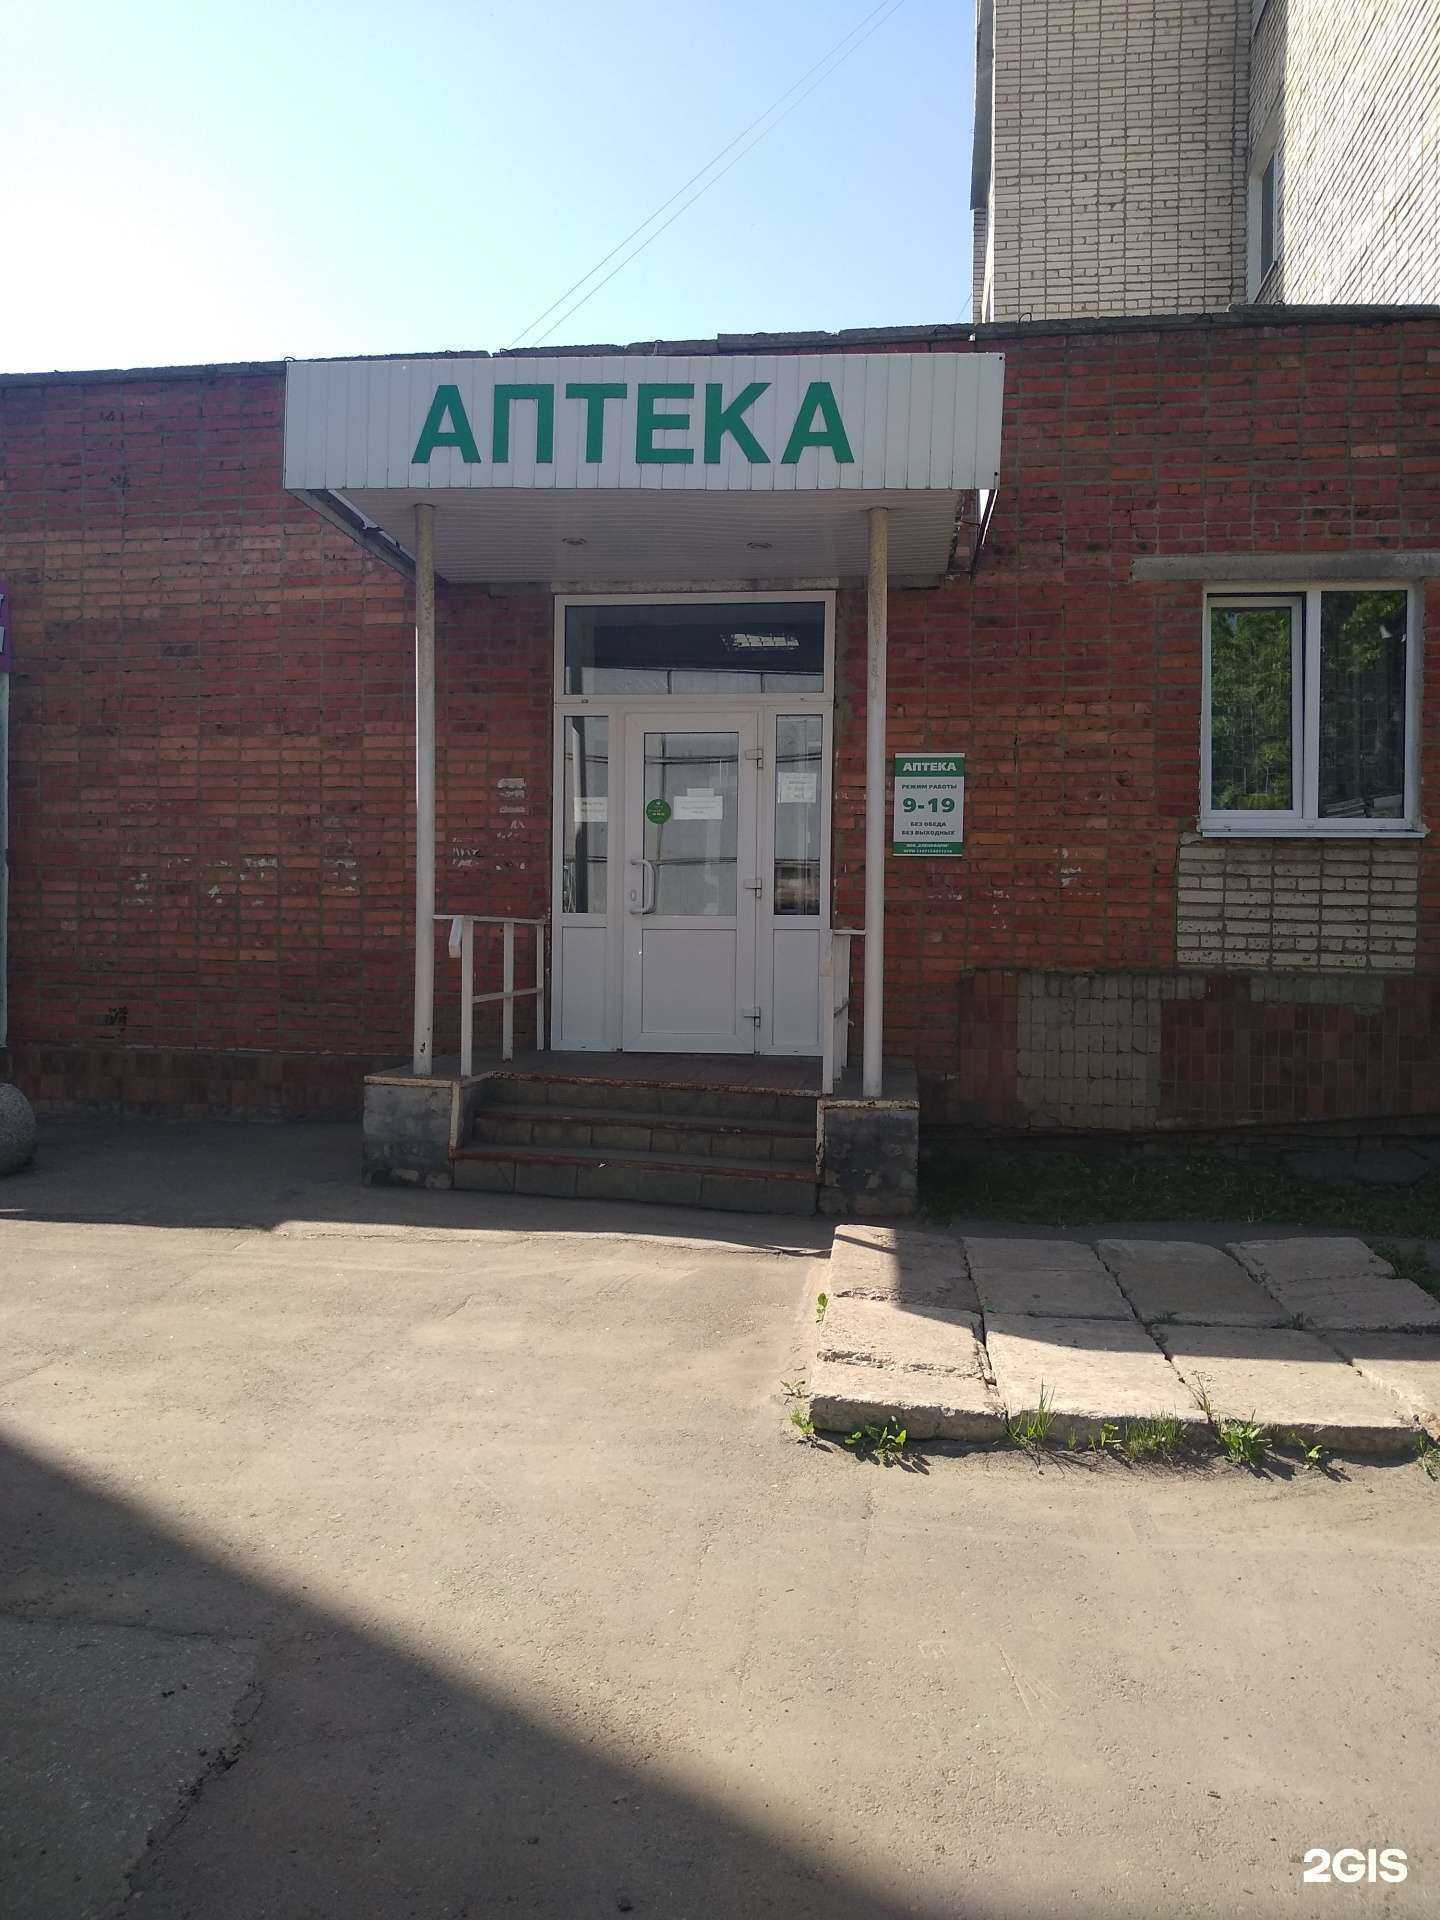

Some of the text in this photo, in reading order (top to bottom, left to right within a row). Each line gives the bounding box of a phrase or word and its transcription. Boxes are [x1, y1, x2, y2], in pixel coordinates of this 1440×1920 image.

[411, 381, 854, 464] АПТЕКА
[902, 762, 957, 772] АПТЕКА
[902, 797, 955, 813] 9-19
